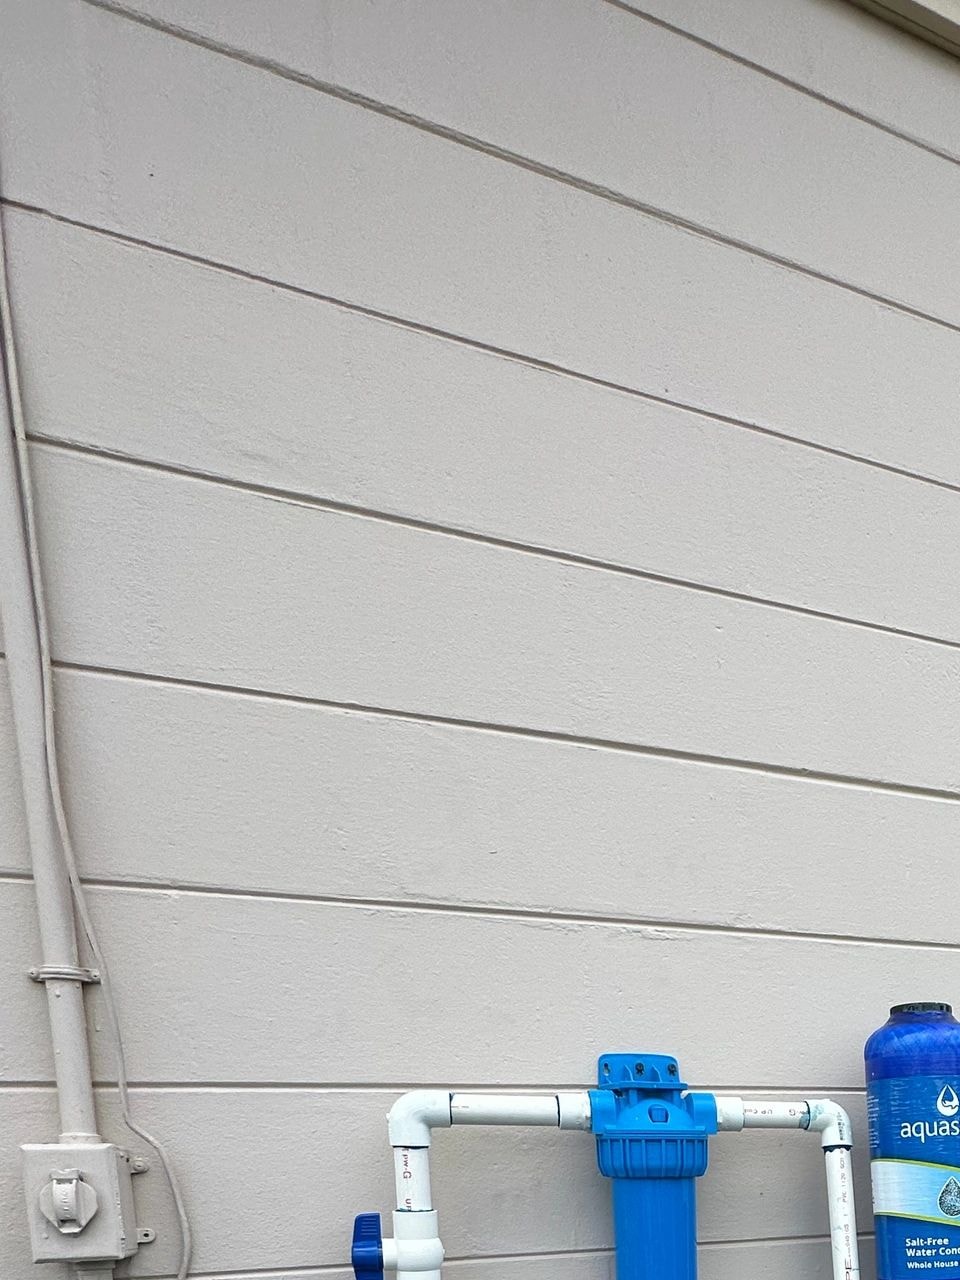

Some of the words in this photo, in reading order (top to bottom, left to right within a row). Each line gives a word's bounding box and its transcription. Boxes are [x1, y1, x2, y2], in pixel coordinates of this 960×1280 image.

[905, 1237, 949, 1246] Salt-Free
[906, 1248, 936, 1257] Water
[907, 1261, 932, 1269] Whole
[934, 1259, 959, 1268] House
